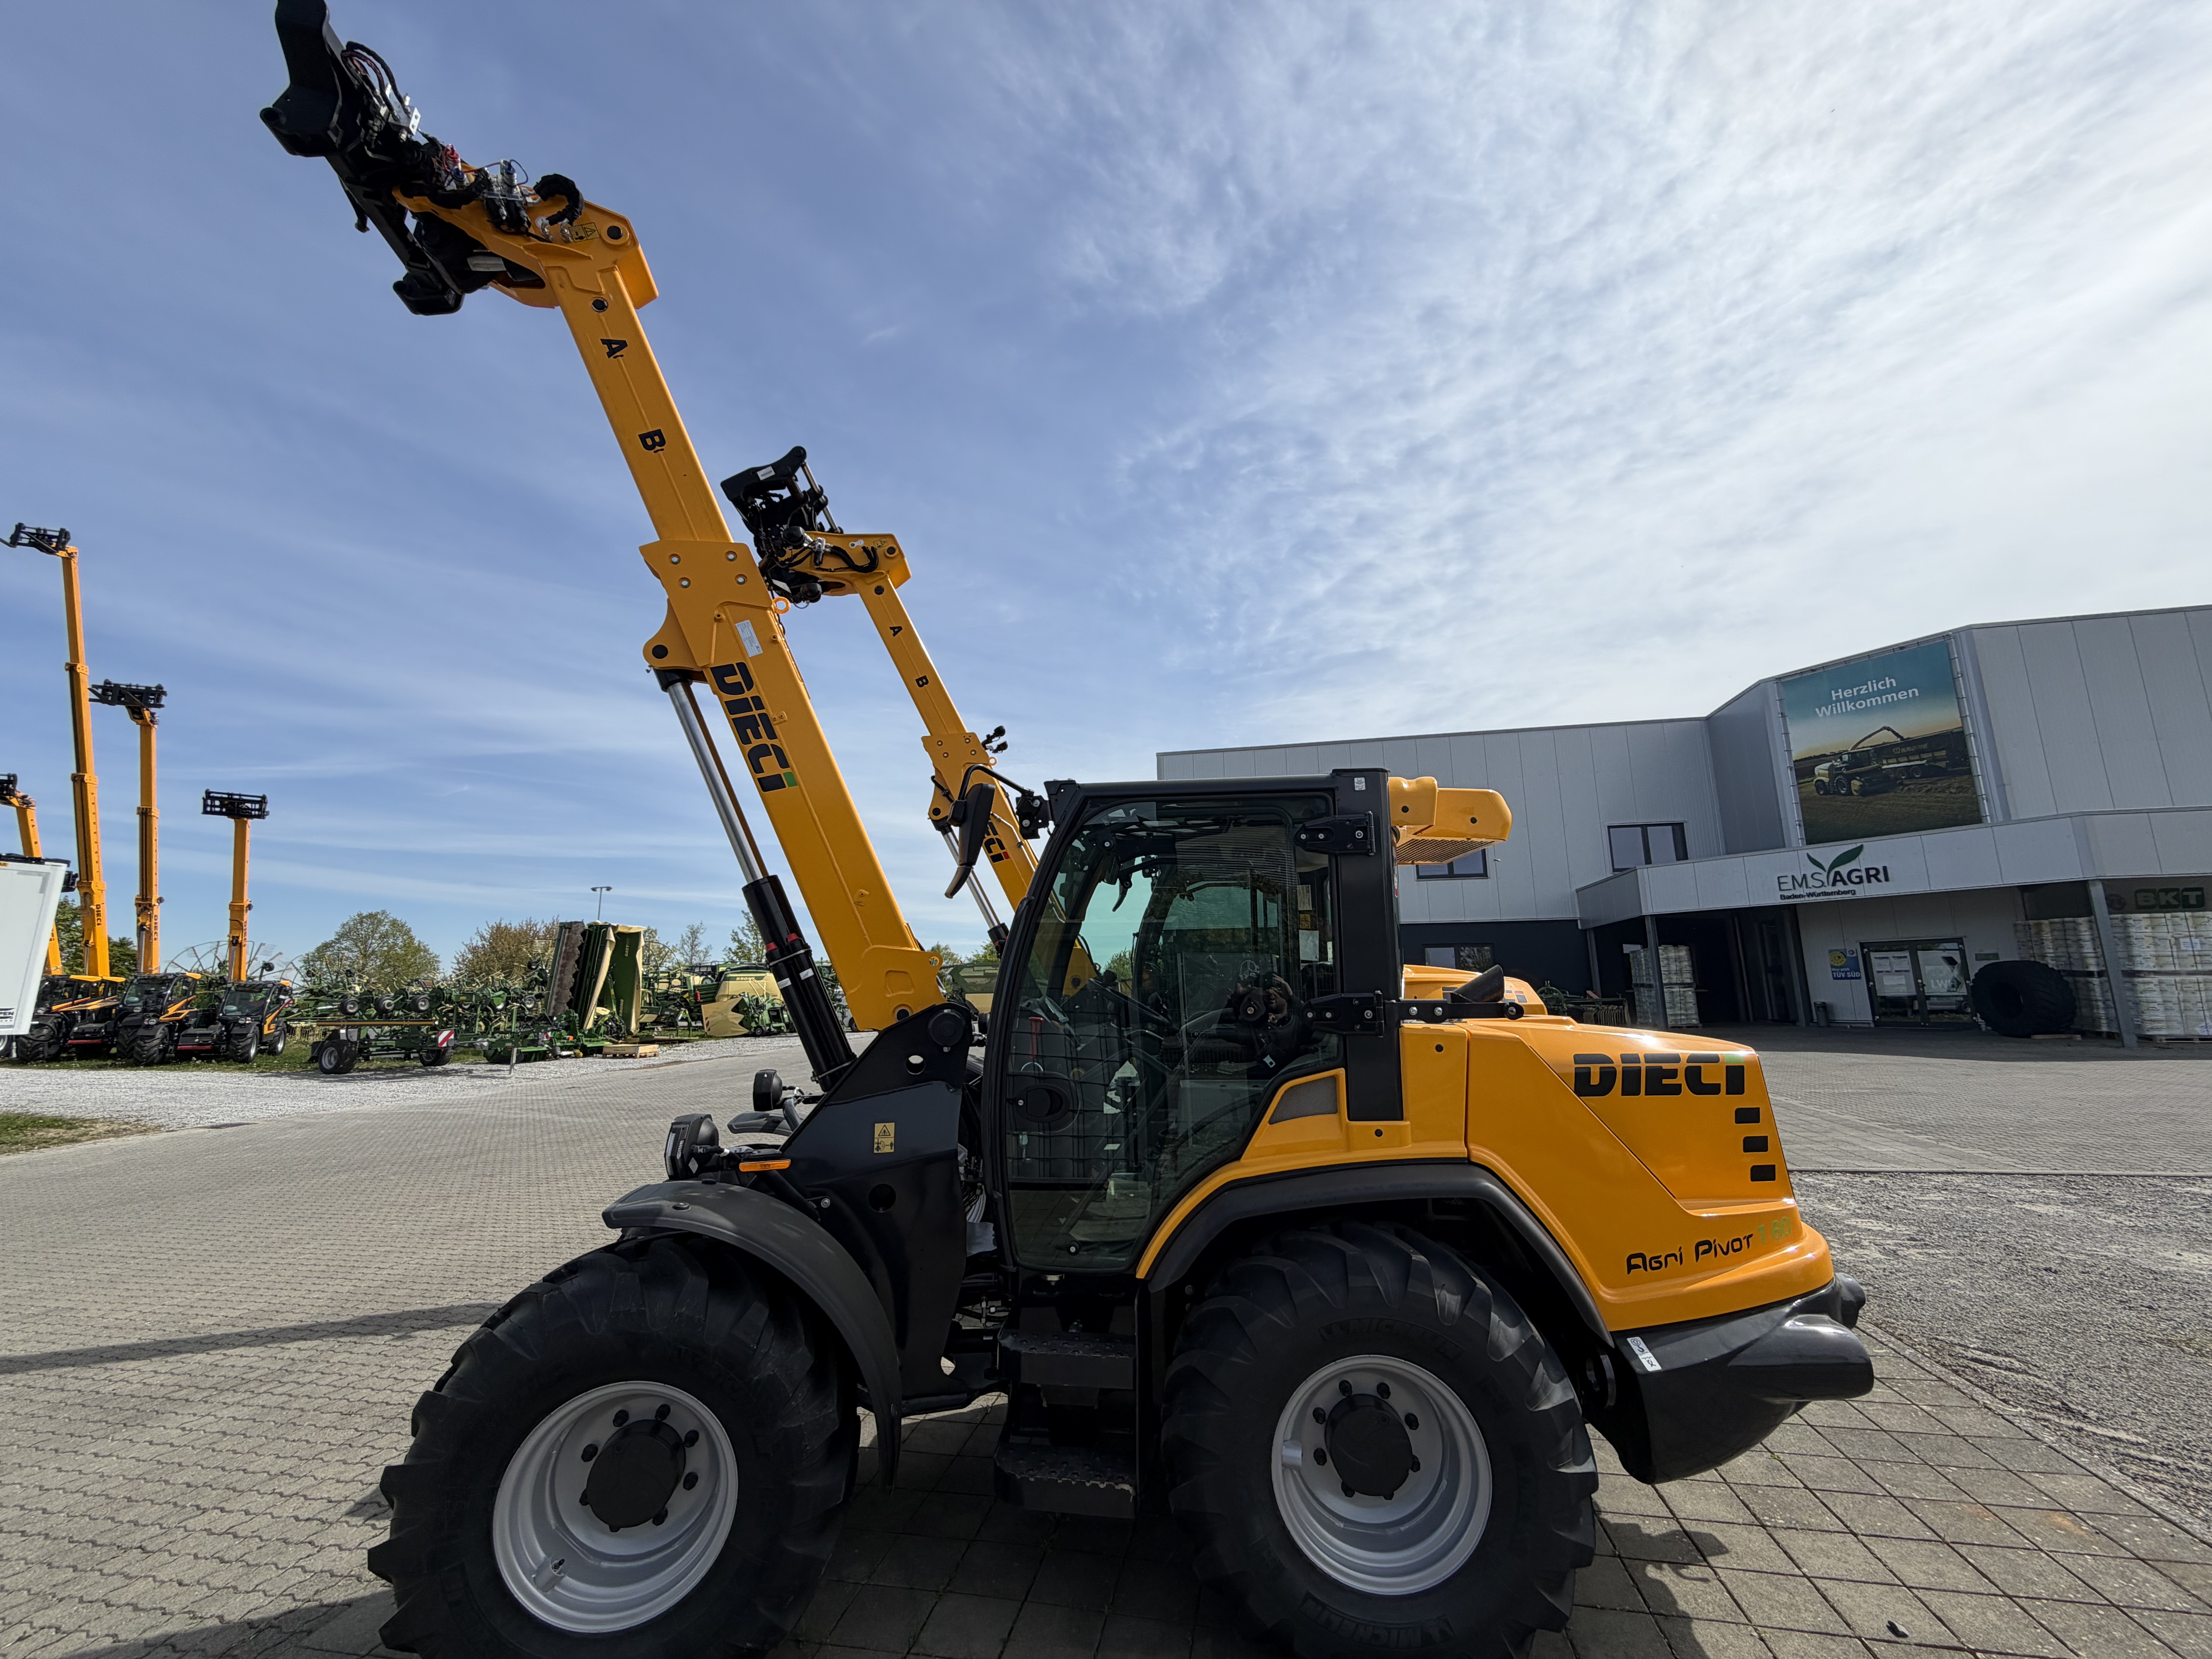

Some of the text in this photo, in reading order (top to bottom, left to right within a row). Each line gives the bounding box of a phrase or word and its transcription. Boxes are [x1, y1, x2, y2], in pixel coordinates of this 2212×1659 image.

[889, 626, 903, 637] A
[915, 675, 929, 687] B
[1831, 677, 1896, 700] Herzlich
[1815, 688, 1919, 717] Willkommen
[710, 662, 798, 788] DIECI
[984, 821, 1010, 863] ECI
[1831, 866, 1889, 886] AGRI
[1780, 889, 1856, 900] Baden-Württemberg
[2135, 888, 2204, 908] BKT
[1573, 1053, 1745, 1097] DIECI
[1626, 1246, 1683, 1275] Agri
